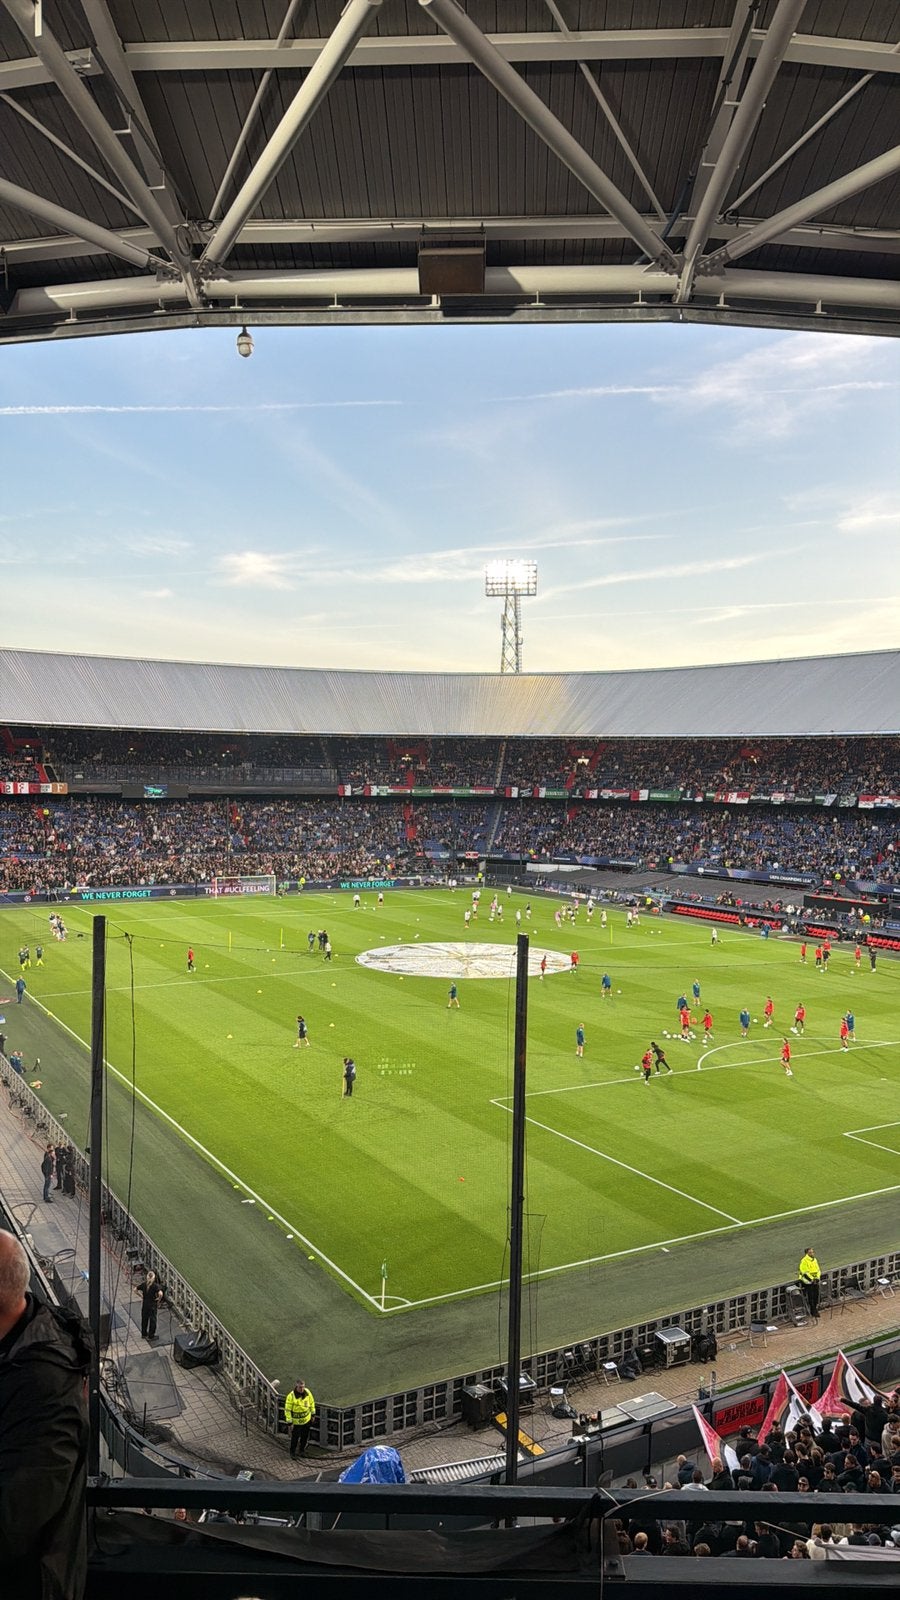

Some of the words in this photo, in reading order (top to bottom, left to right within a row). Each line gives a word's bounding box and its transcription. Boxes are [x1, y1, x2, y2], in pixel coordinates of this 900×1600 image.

[351, 881, 371, 889] NEVER
[372, 880, 395, 888] FORGET
[224, 885, 270, 894] #UCLFEELING
[81, 892, 94, 900] WE
[95, 891, 121, 900] NEVER
[122, 890, 152, 898] FORGET
